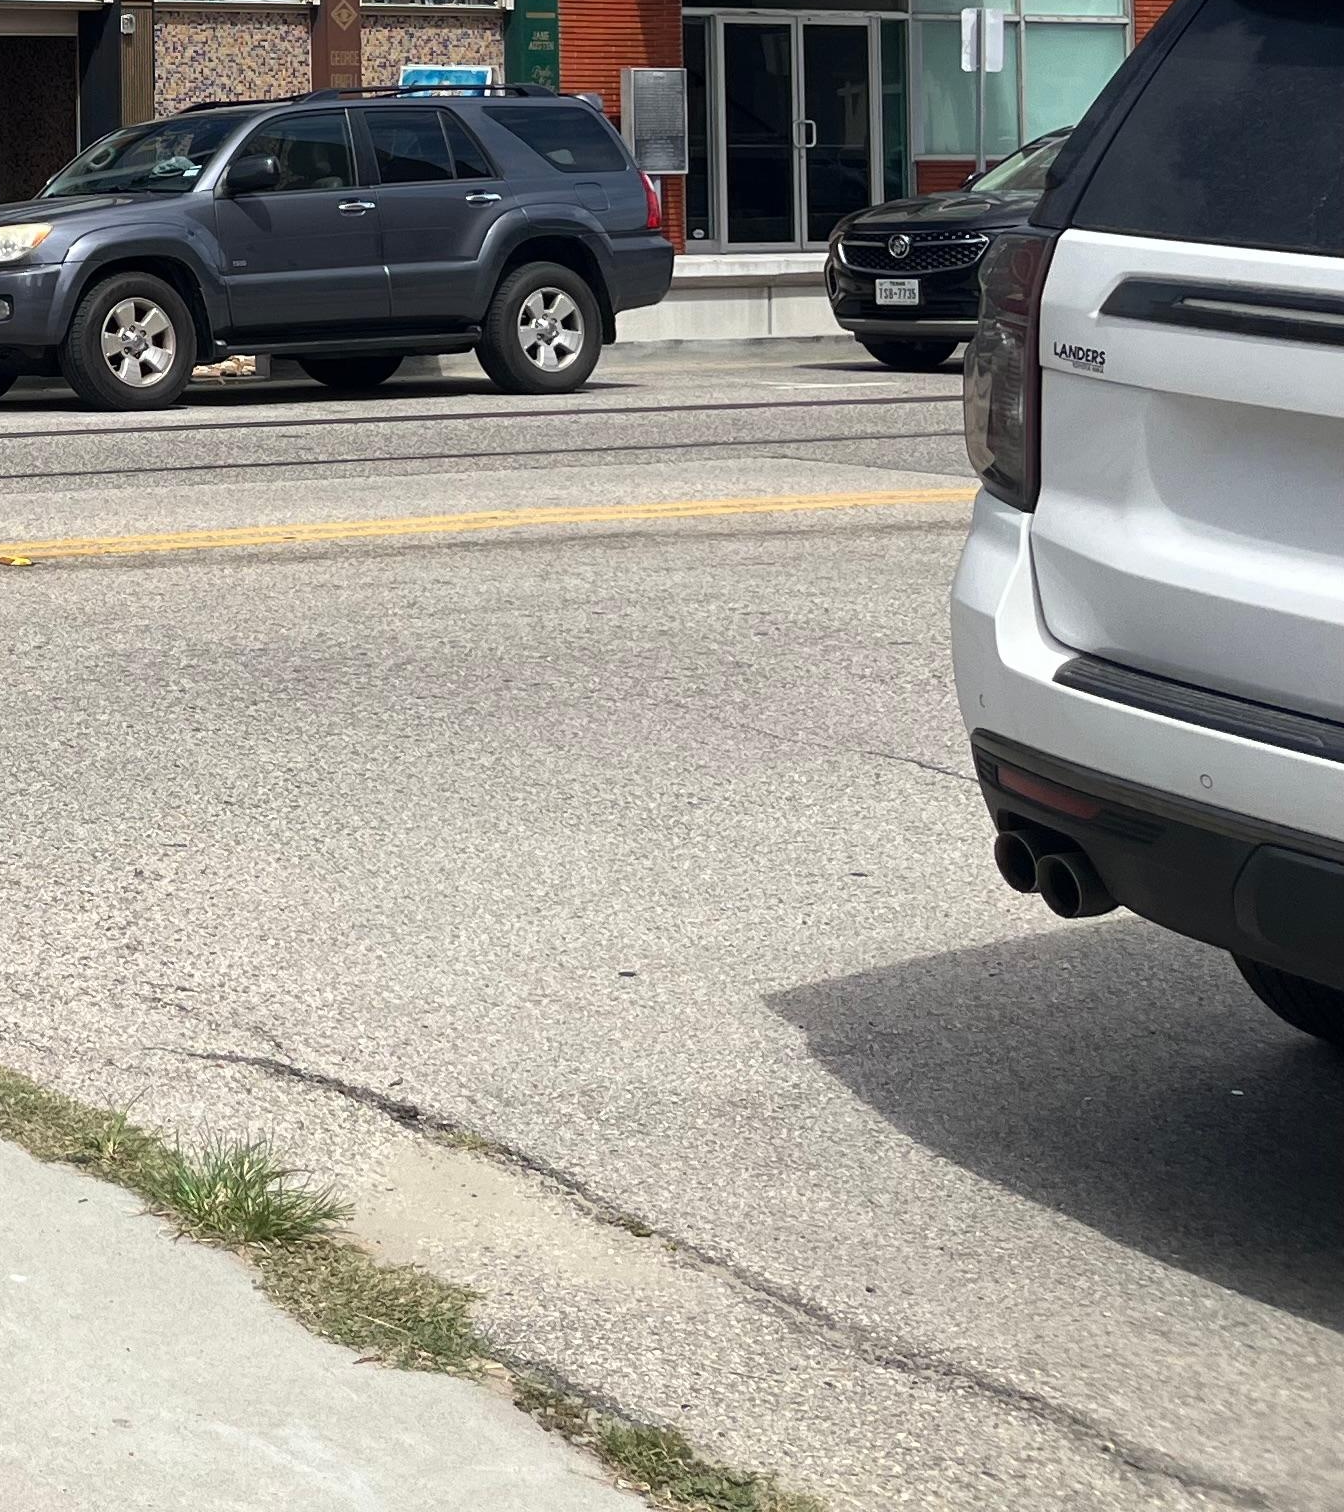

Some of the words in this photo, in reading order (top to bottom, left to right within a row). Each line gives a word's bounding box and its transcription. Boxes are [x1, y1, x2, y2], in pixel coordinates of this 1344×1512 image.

[531, 31, 550, 41] JANE
[528, 40, 555, 51] AUSTEN
[330, 50, 359, 66] GEORGE
[1053, 341, 1106, 366] LANDERS
